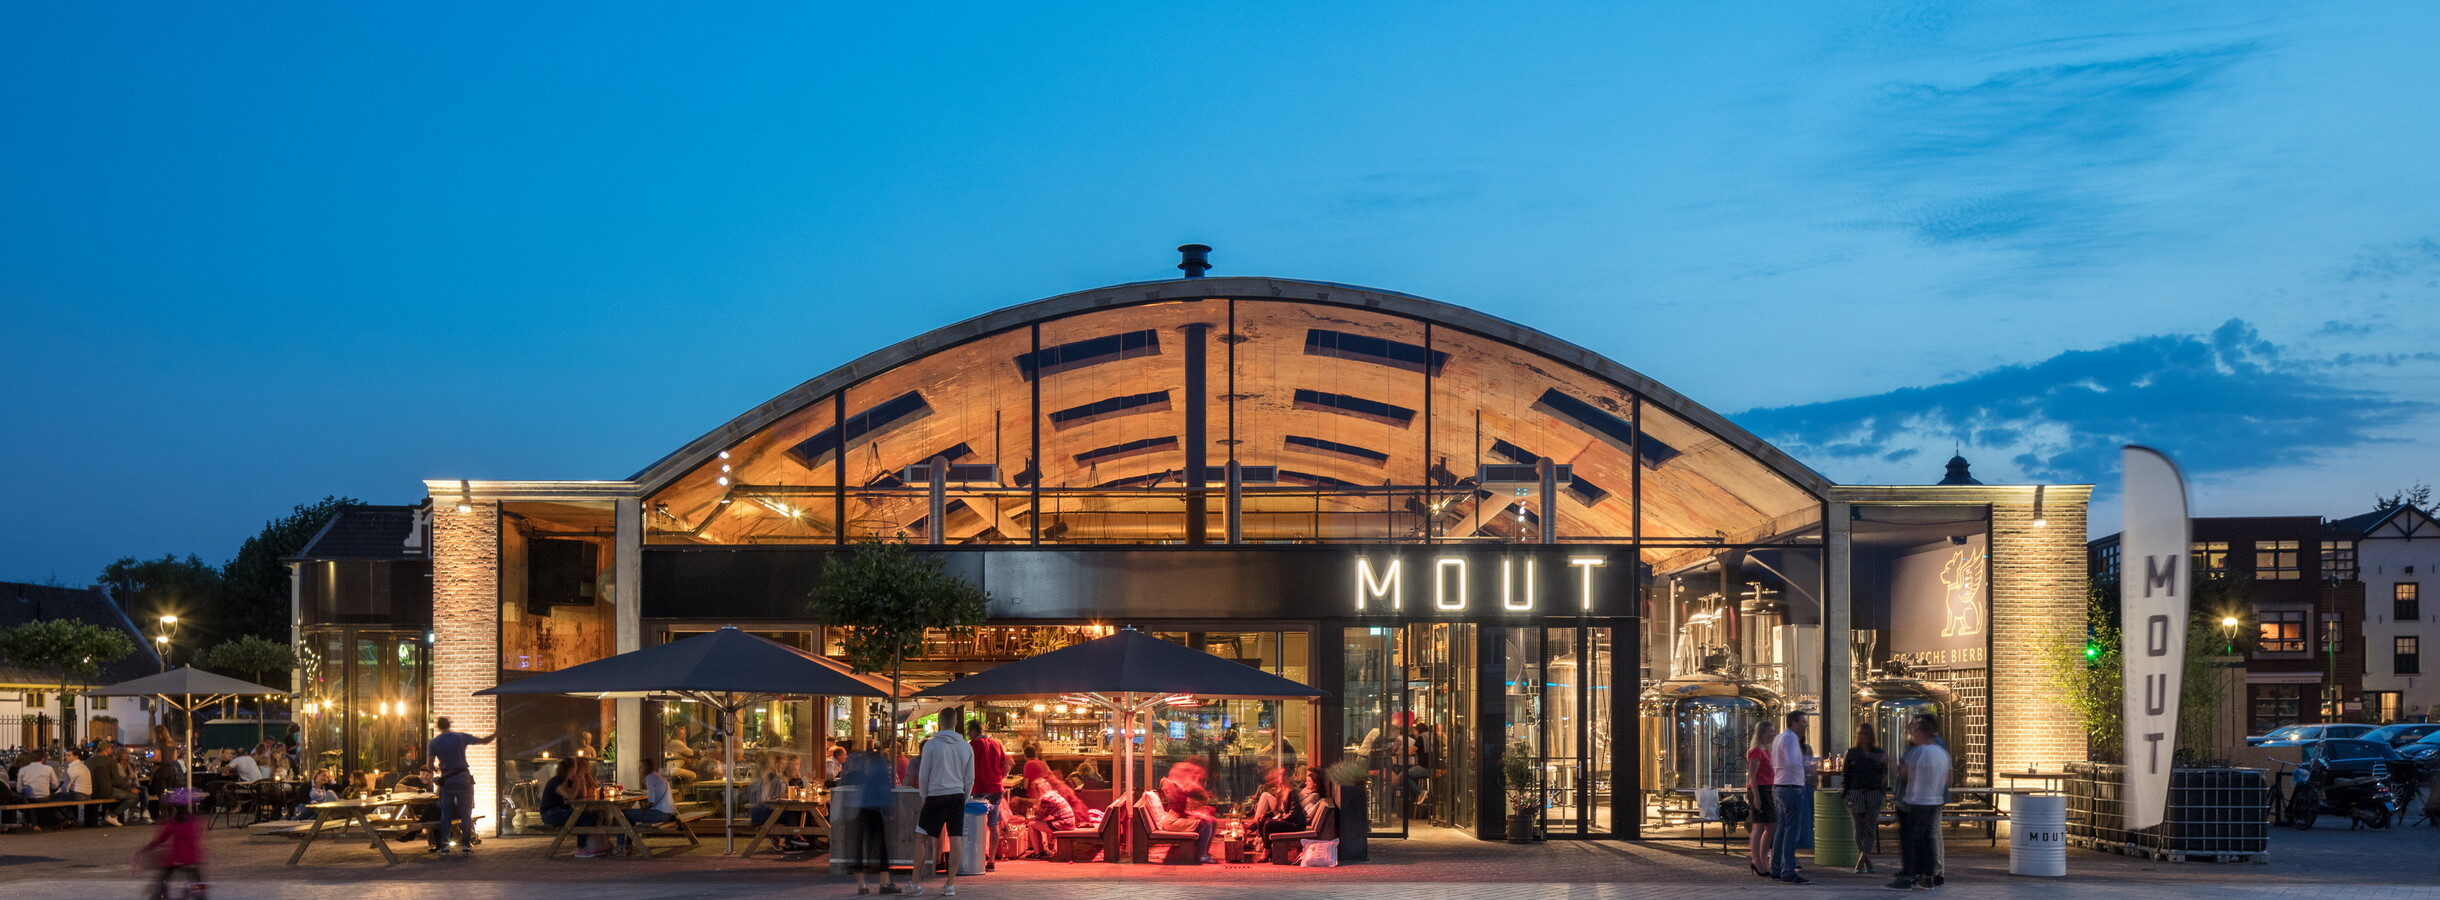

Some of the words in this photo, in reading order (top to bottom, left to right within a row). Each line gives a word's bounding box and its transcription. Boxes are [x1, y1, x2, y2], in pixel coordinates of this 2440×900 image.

[1355, 555, 1607, 612] MOUT
[1893, 650, 1946, 664] GISCHE
[1951, 647, 1987, 663] BIERB
[2144, 554, 2177, 774] MOUT
[2029, 832, 2065, 842] MOUT
